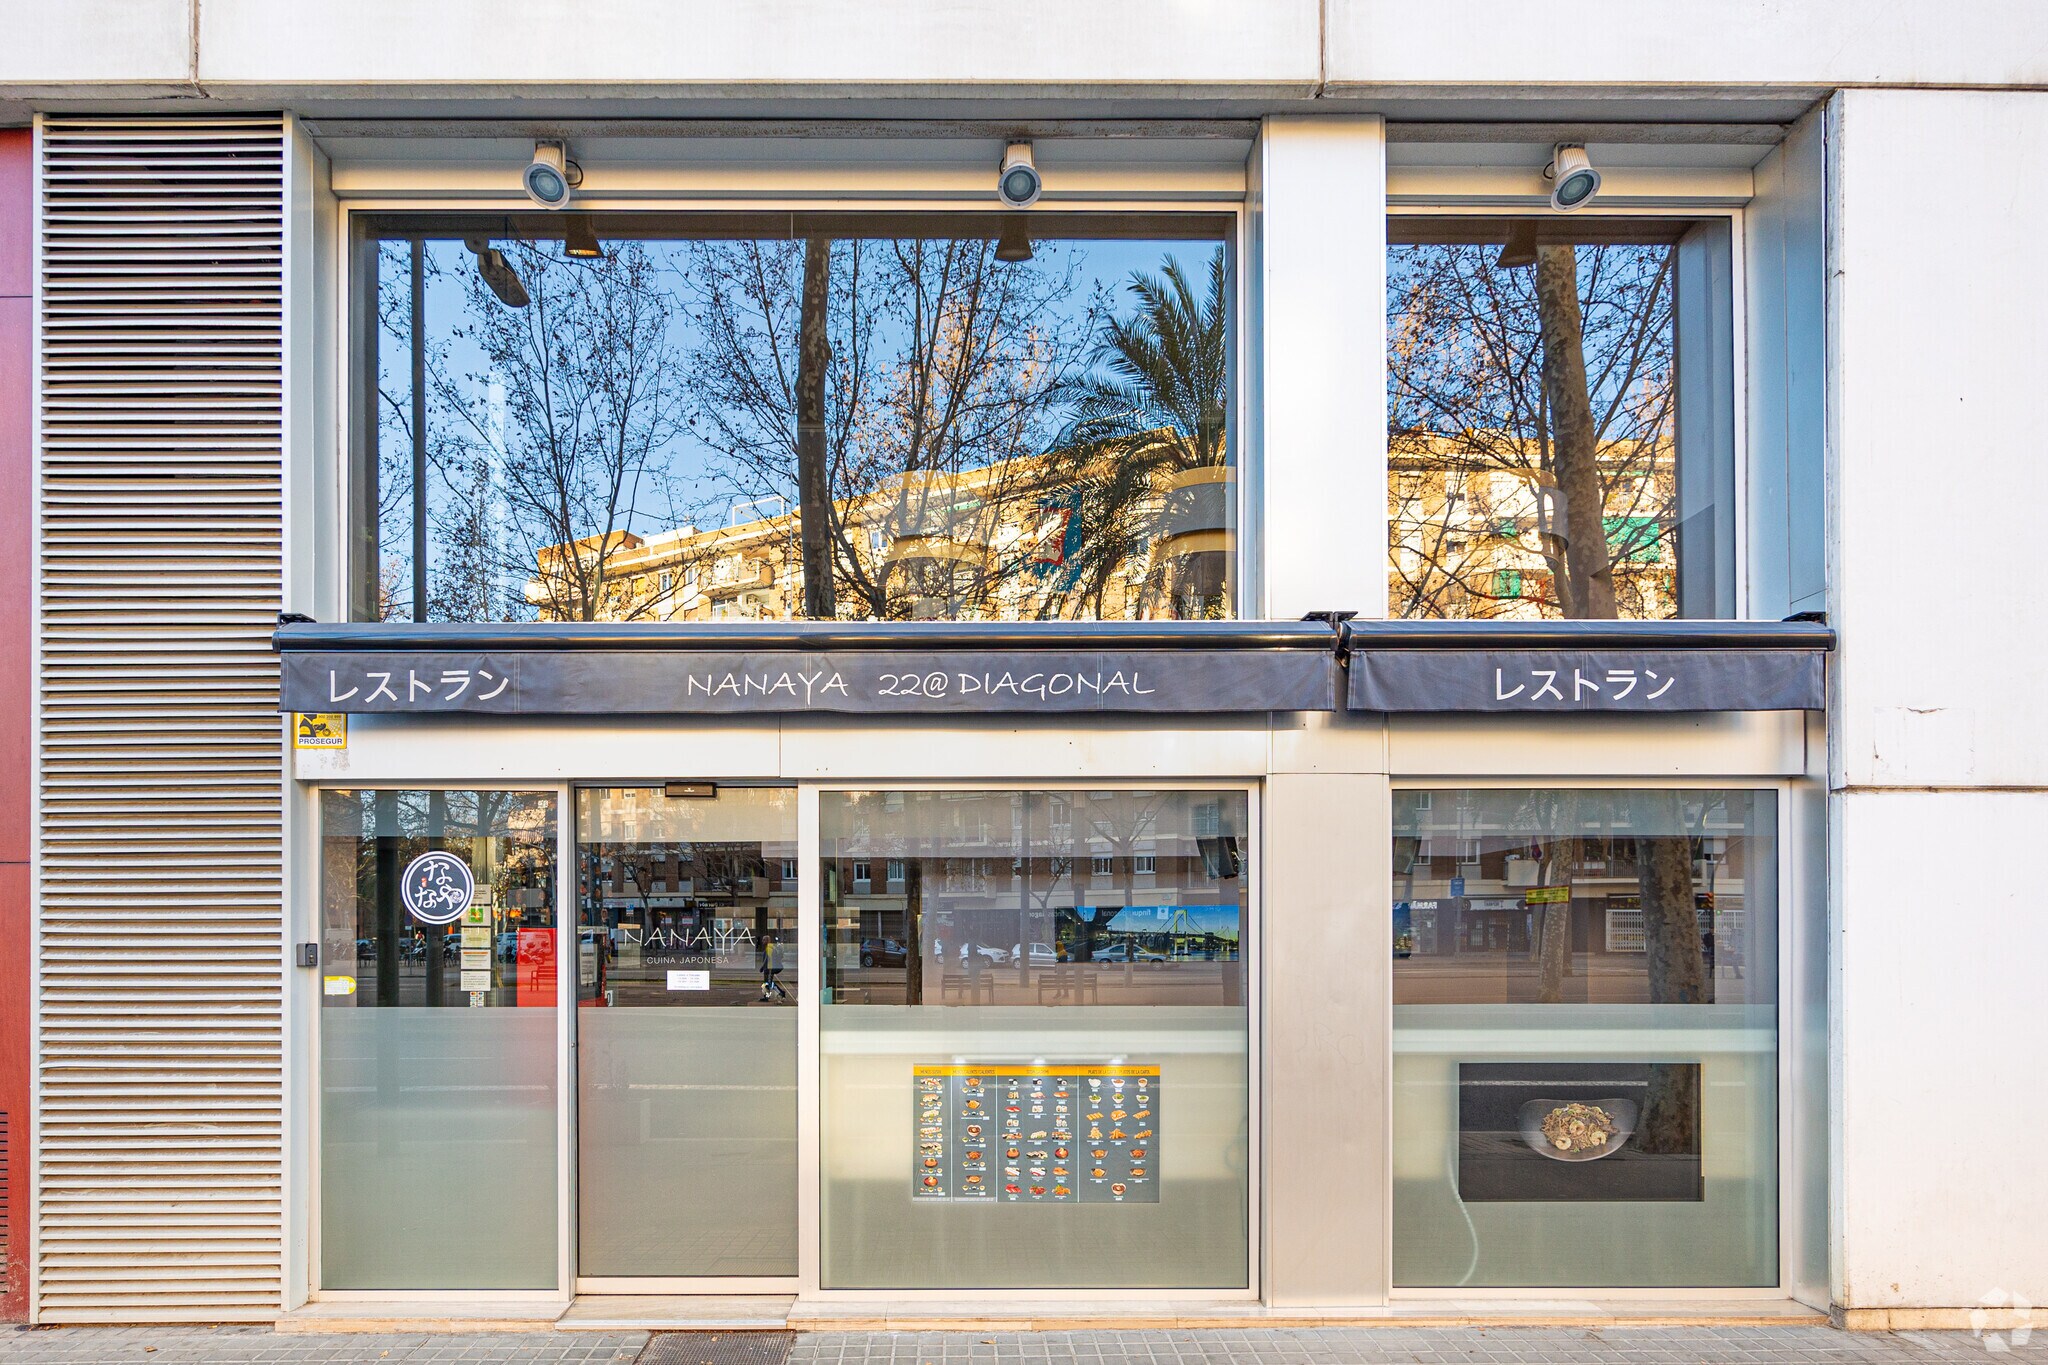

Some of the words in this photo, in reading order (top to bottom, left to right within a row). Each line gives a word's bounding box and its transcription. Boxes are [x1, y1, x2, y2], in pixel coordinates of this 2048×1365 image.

[328, 669, 509, 703] レストラン
[687, 672, 849, 705] NANAYA
[878, 672, 949, 698] 22@
[959, 671, 1156, 702] DIAGONAL
[1495, 667, 1676, 701] レストラン
[624, 927, 756, 955] NANAYA
[647, 956, 676, 964] CUINA
[679, 956, 730, 964] JAPONESA
